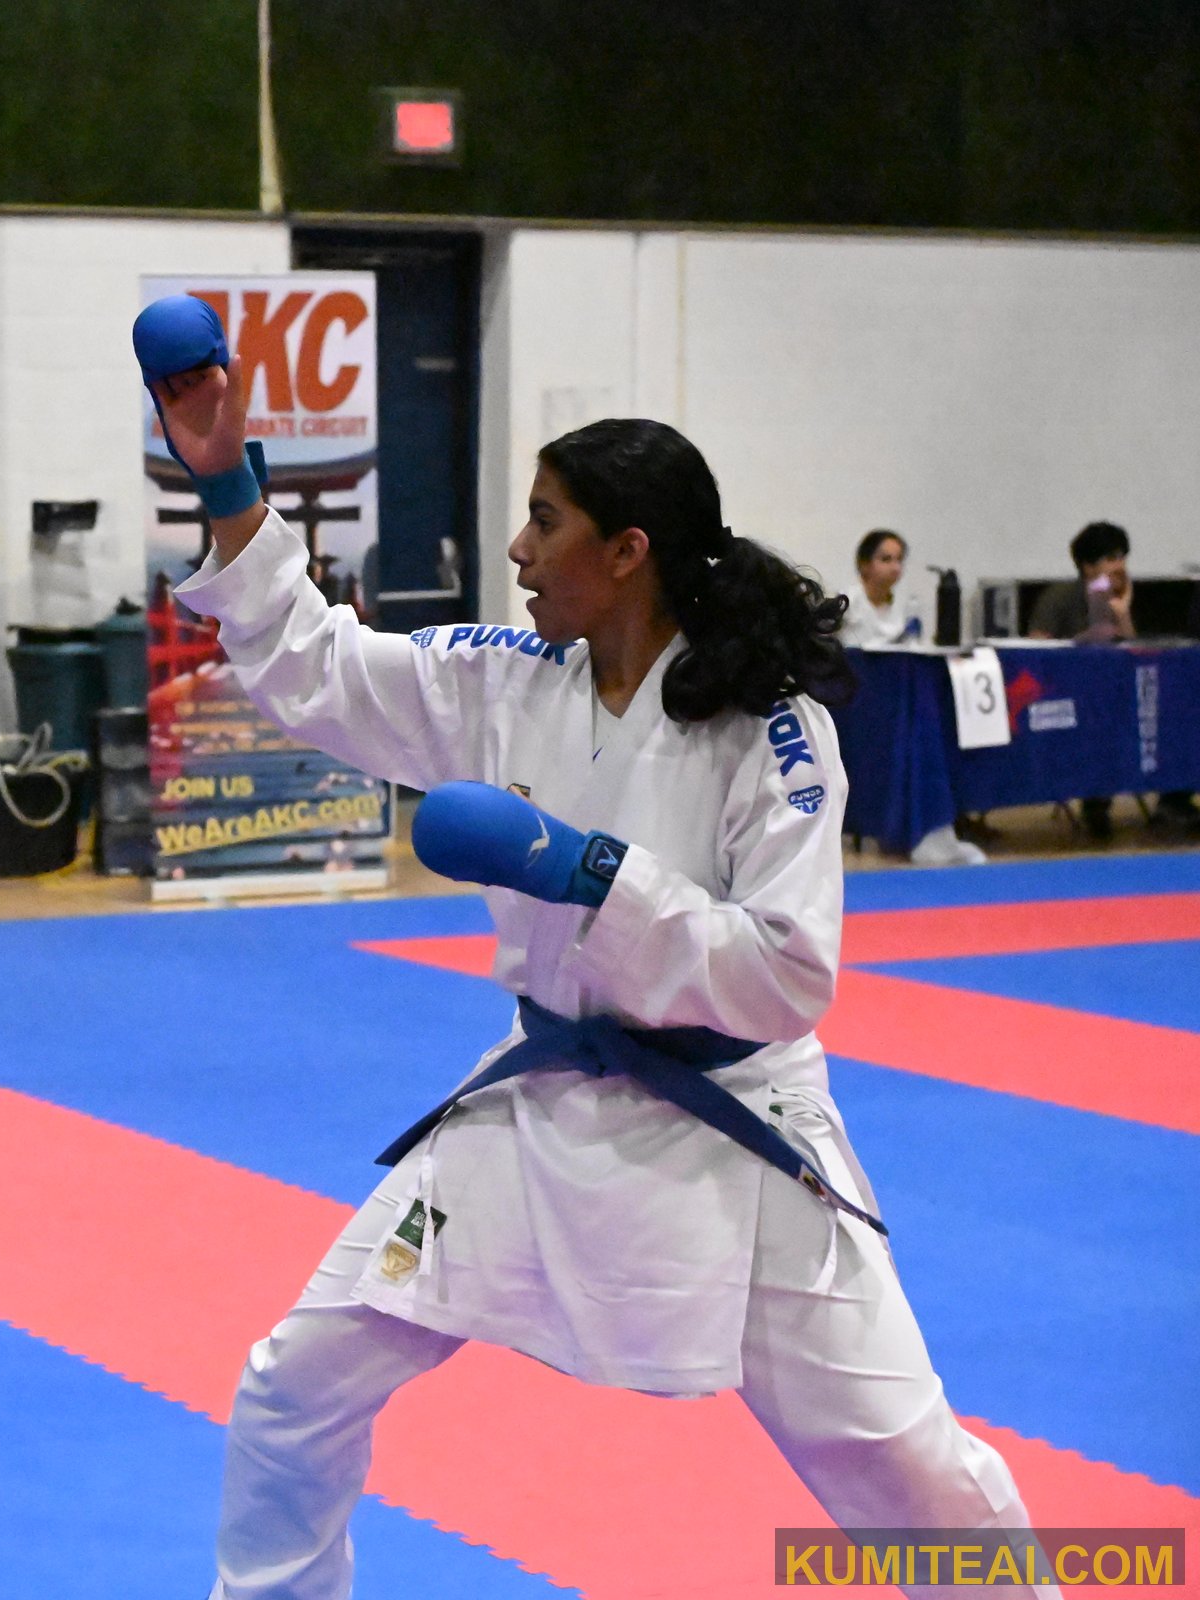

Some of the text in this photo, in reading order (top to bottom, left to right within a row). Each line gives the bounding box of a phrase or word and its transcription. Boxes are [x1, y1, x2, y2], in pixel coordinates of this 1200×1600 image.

[447, 625, 578, 666] PUNOK
[974, 671, 996, 715] 3
[161, 776, 254, 799] JOIN US
[156, 793, 381, 852] WeAreAKC.com
